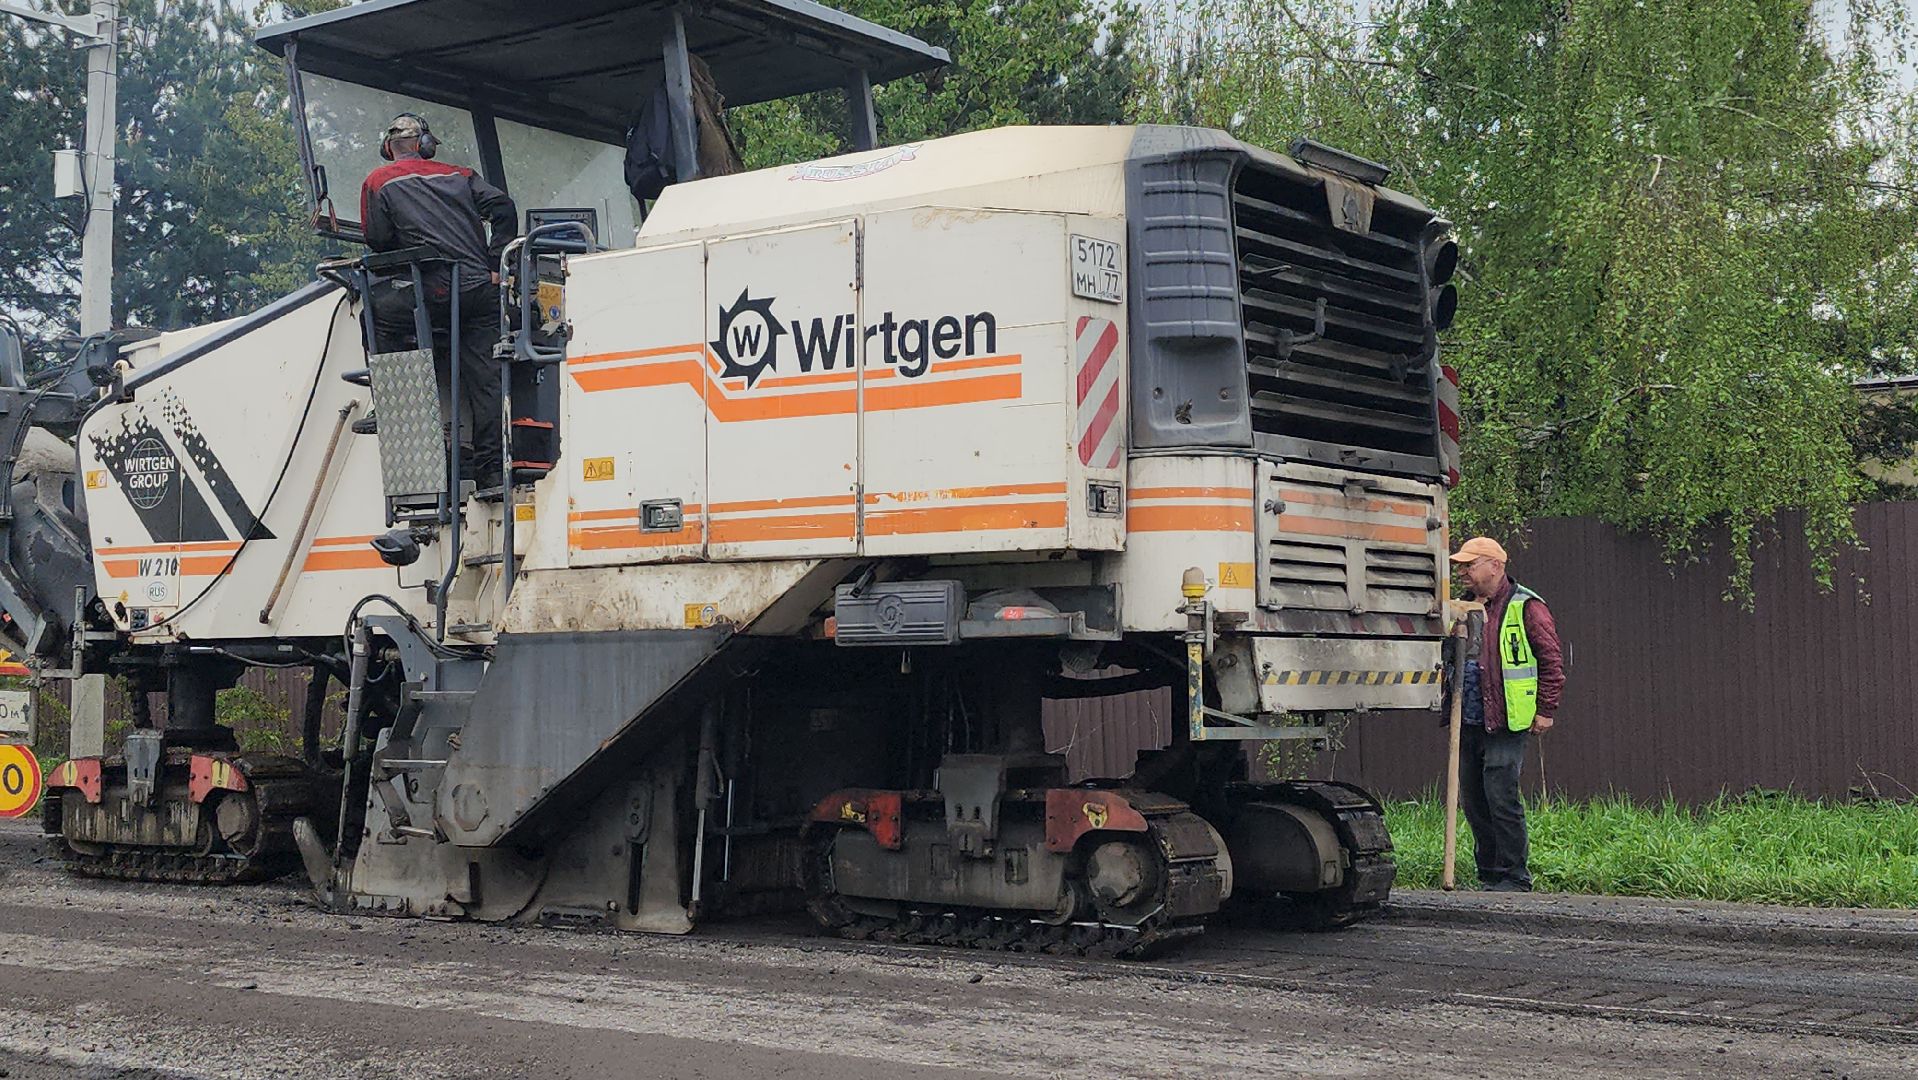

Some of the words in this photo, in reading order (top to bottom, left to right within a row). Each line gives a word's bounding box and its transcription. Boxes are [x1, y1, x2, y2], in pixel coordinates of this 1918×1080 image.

[1078, 238, 1115, 269] 5172
[1104, 272, 1118, 292] 77
[733, 324, 762, 358] W
[791, 311, 997, 378] Wirtgen
[124, 455, 175, 472] WIRTGEN
[129, 473, 169, 489] GROUP
[139, 558, 152, 576] W
[154, 557, 178, 576] 210
[149, 586, 165, 597] RUS
